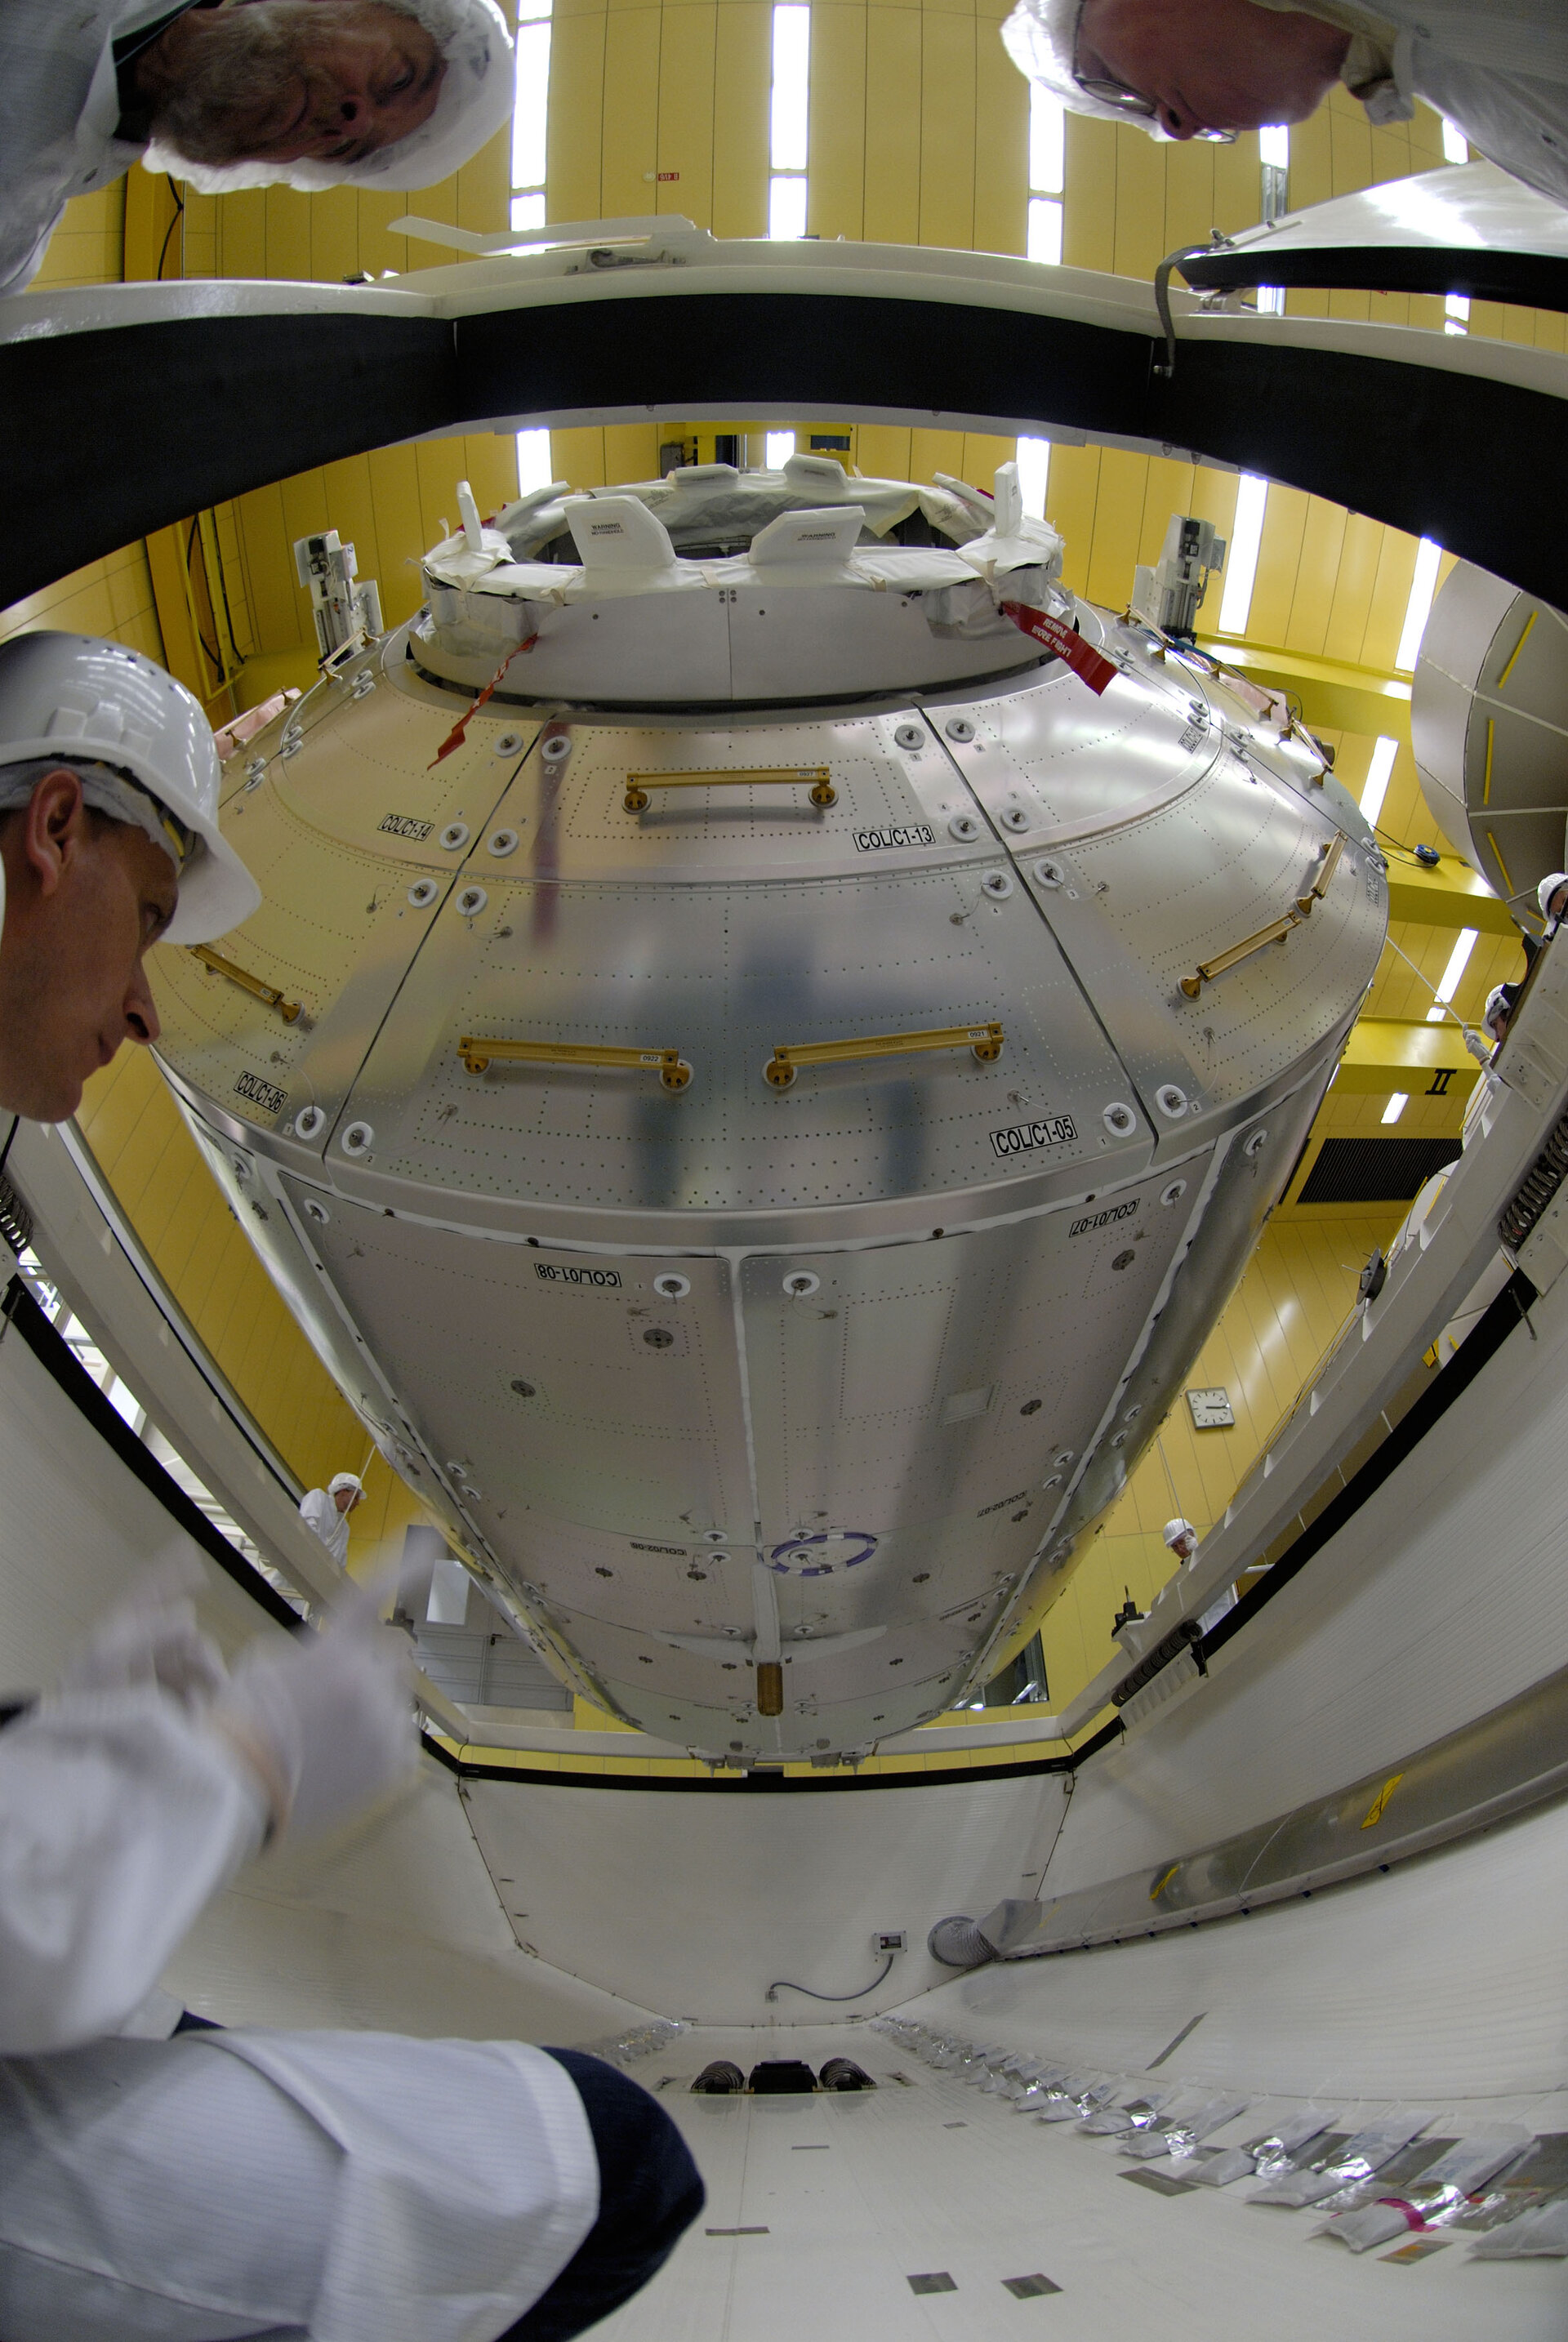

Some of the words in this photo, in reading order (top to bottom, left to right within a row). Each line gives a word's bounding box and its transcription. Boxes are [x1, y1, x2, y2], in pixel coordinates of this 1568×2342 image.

[591, 523, 621, 531] WARNING
[1043, 618, 1068, 639] REMOVE
[381, 815, 432, 839] COL/C1-14
[858, 827, 933, 849] COL/C1-13
[237, 1074, 284, 1111] COL/C1-06
[1424, 1068, 1458, 1096] II
[996, 1118, 1074, 1153] COL/C1-05
[1071, 1200, 1137, 1236] COL/01-07
[537, 1265, 617, 1286] COL/01-08
